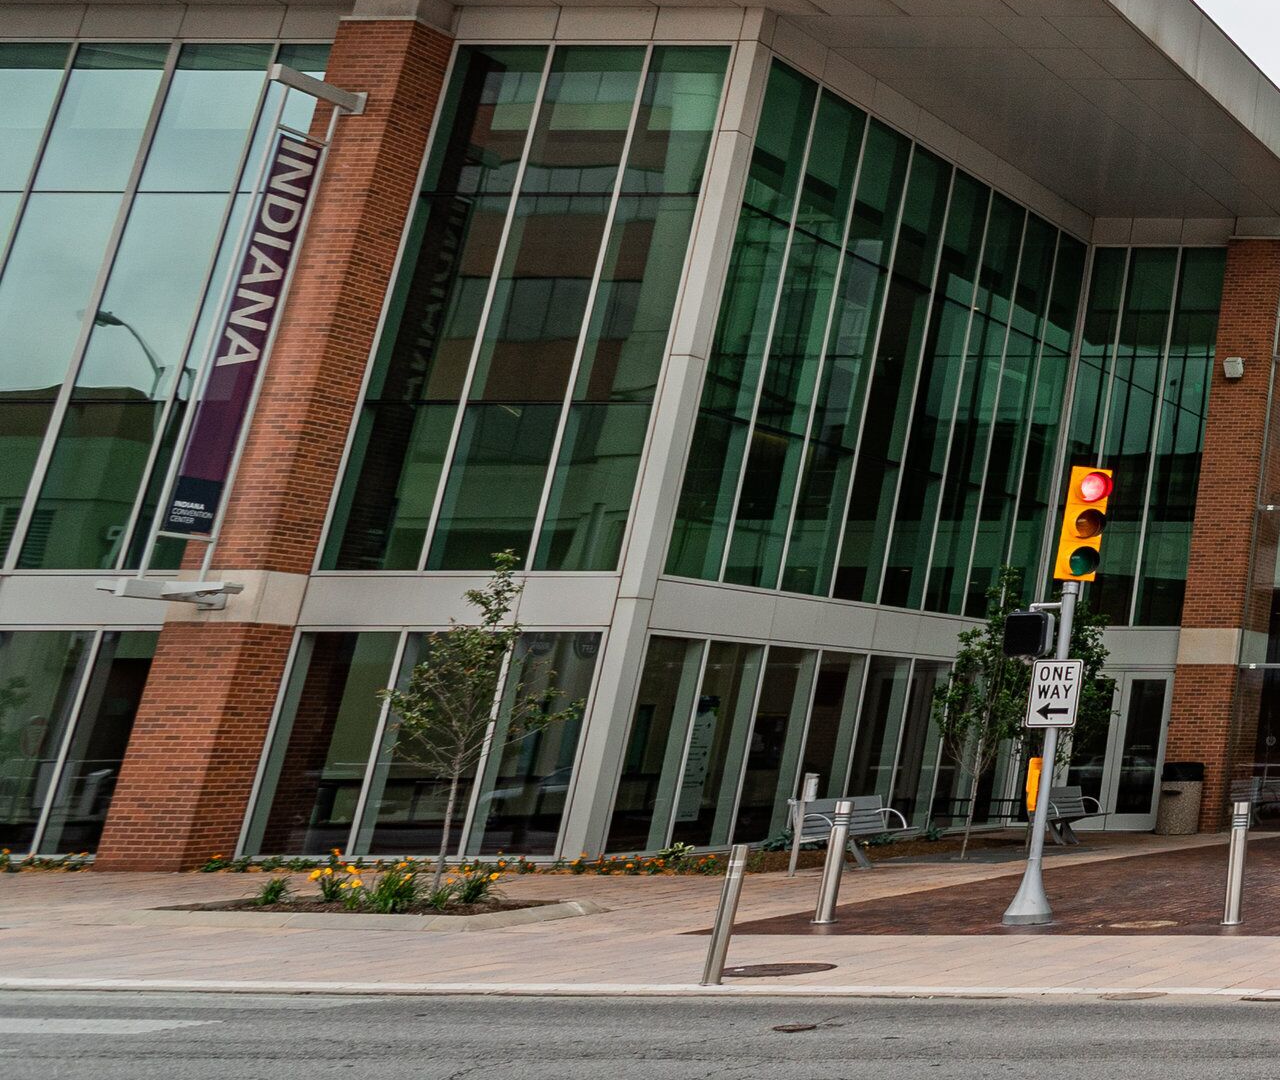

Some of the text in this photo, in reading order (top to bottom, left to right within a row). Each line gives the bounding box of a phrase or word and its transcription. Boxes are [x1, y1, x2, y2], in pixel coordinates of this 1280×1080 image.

[215, 137, 318, 367] INDIANA
[173, 500, 205, 510] INDIANA
[169, 515, 195, 524] CENTER
[171, 507, 213, 519] CONVENTION
[1040, 666, 1075, 681] ONE
[1038, 684, 1073, 699] WAY
